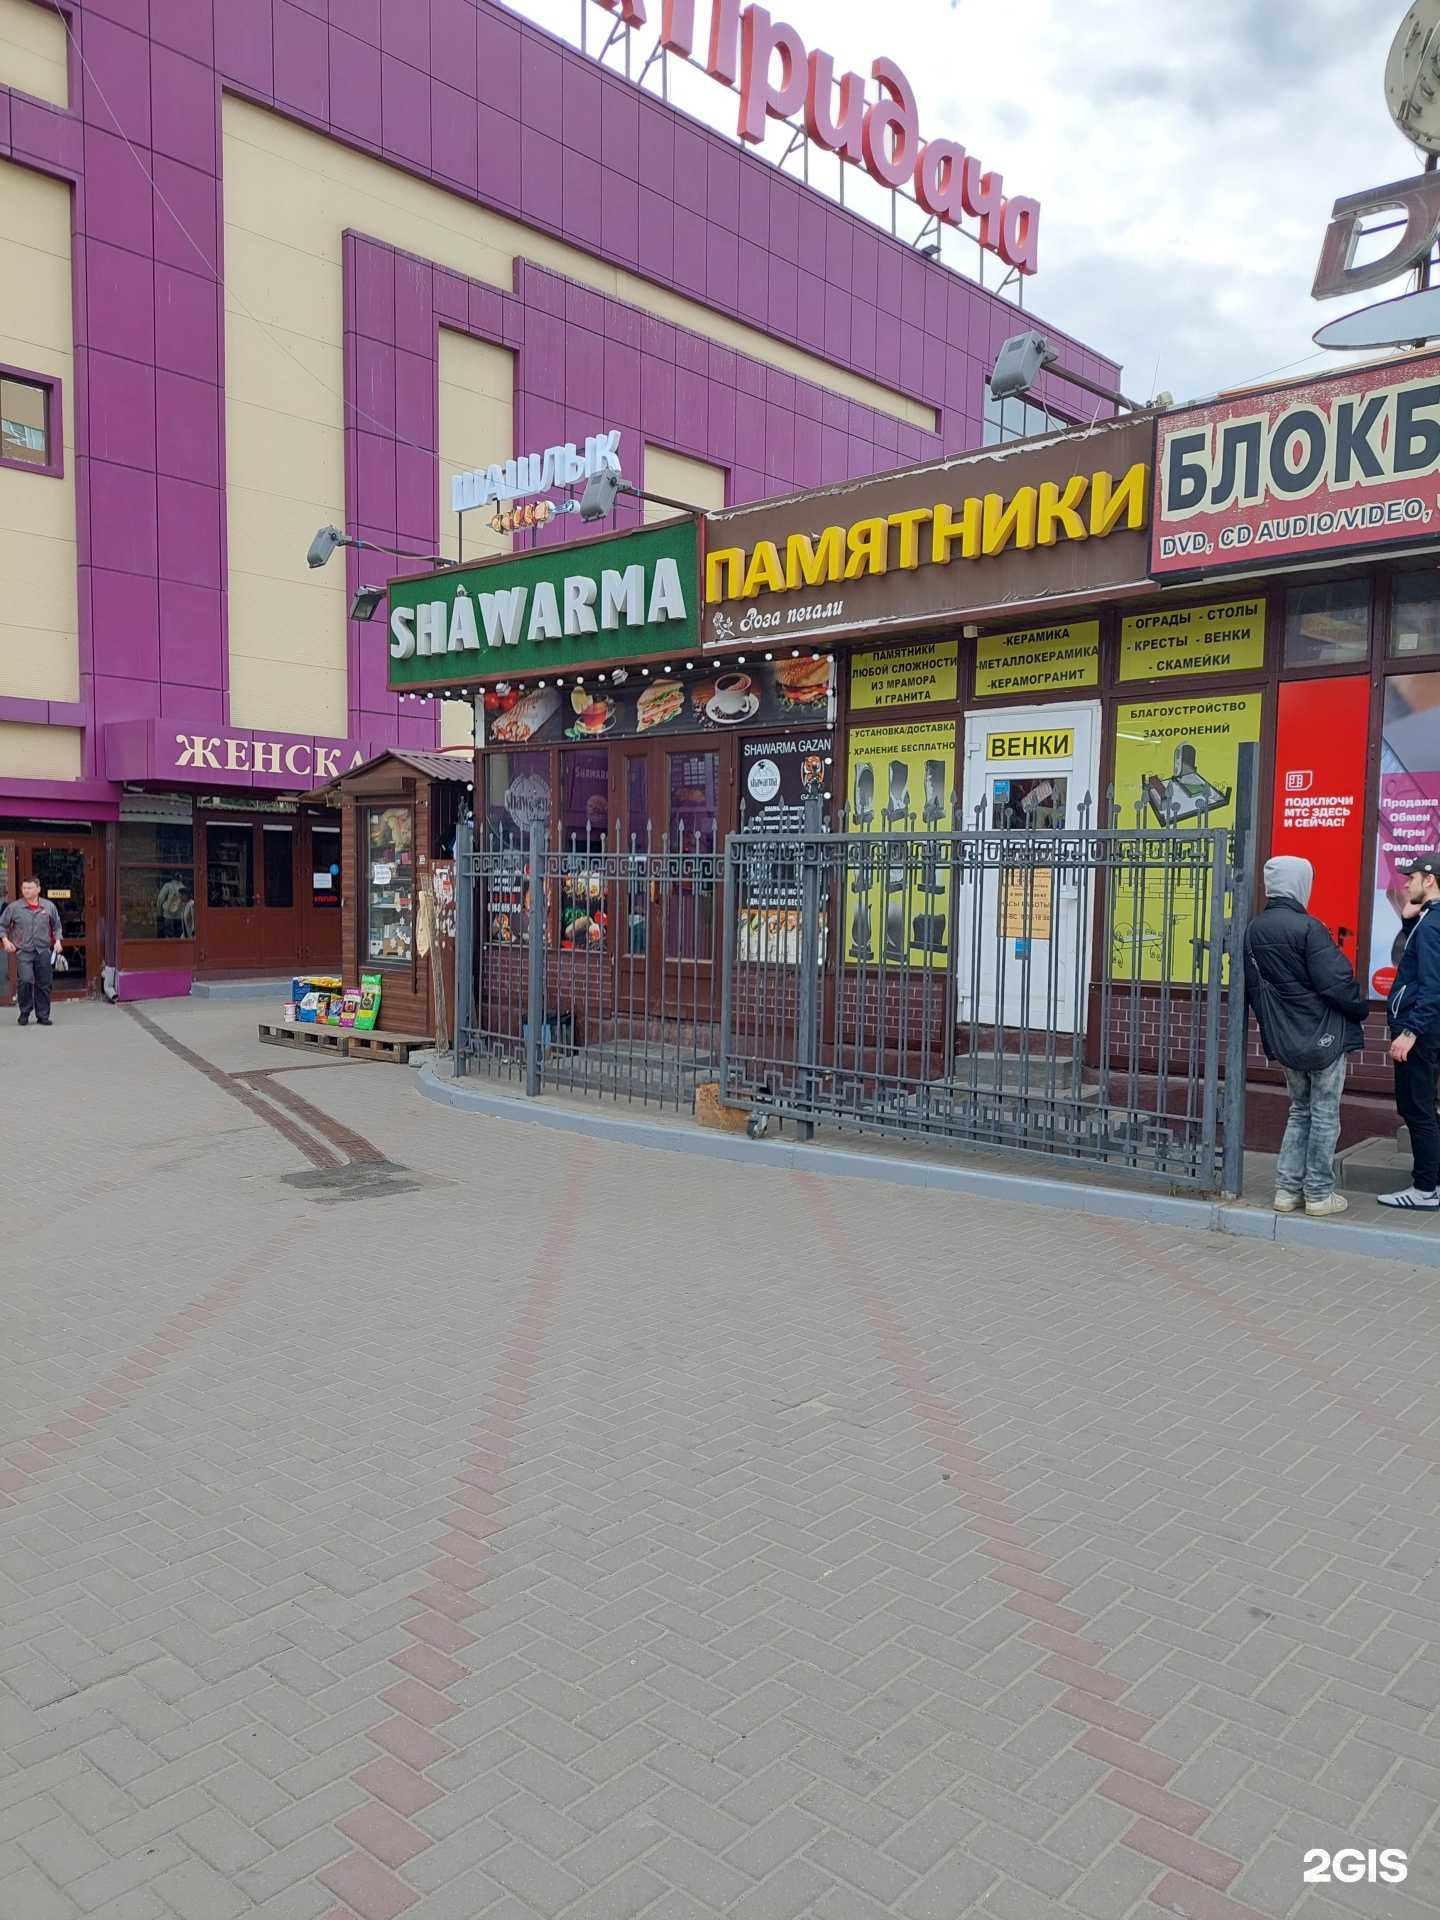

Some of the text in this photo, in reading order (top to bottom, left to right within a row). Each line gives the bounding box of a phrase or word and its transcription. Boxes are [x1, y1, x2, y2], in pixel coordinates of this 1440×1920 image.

[452, 430, 621, 512] ШАШЛЫК
[706, 463, 1149, 604] ПАМЯТНИКИ
[1162, 498, 1432, 558] DVD, CD AUDIO/VIDEO,
[390, 557, 687, 660] SHAWARMA
[740, 600, 843, 632] Роза печали
[1135, 603, 1258, 629] ОГРАДЫ СТОЛЫ
[1134, 628, 1251, 652] КРЕСТЫ ВЕНКИ
[873, 644, 935, 661] ПАМЯТНИКИ
[852, 656, 957, 678] ЛЮБОЙ СЛОЖНОСТИ
[1156, 653, 1231, 671] СКАМЕЙКИ
[871, 675, 936, 691] ИЗ МРАМОРА
[875, 691, 931, 704] И ГРАНИТА
[1130, 701, 1246, 719] БЛАГОУСТРОЙСТВО
[855, 722, 955, 738] УСТАНОВКА/ДОСТАВКА
[1143, 723, 1230, 738] ЗАХОРОНЕНИЙ
[744, 738, 831, 756] SHAWARMA GAZAN
[854, 741, 956, 755] ХРАНЕНИЕ БЕСПЛАТНО
[992, 734, 1069, 757] ВЕНКИ
[1285, 795, 1354, 807] ПОДКЛЮЧИ
[1383, 798, 1439, 809] Продажа
[1284, 807, 1351, 817] МТС ЗДЕСЬ
[1284, 817, 1345, 828] И СЕЙЧАС!
[1392, 827, 1425, 838] Игры
[1382, 842, 1435, 852] Фильмы
